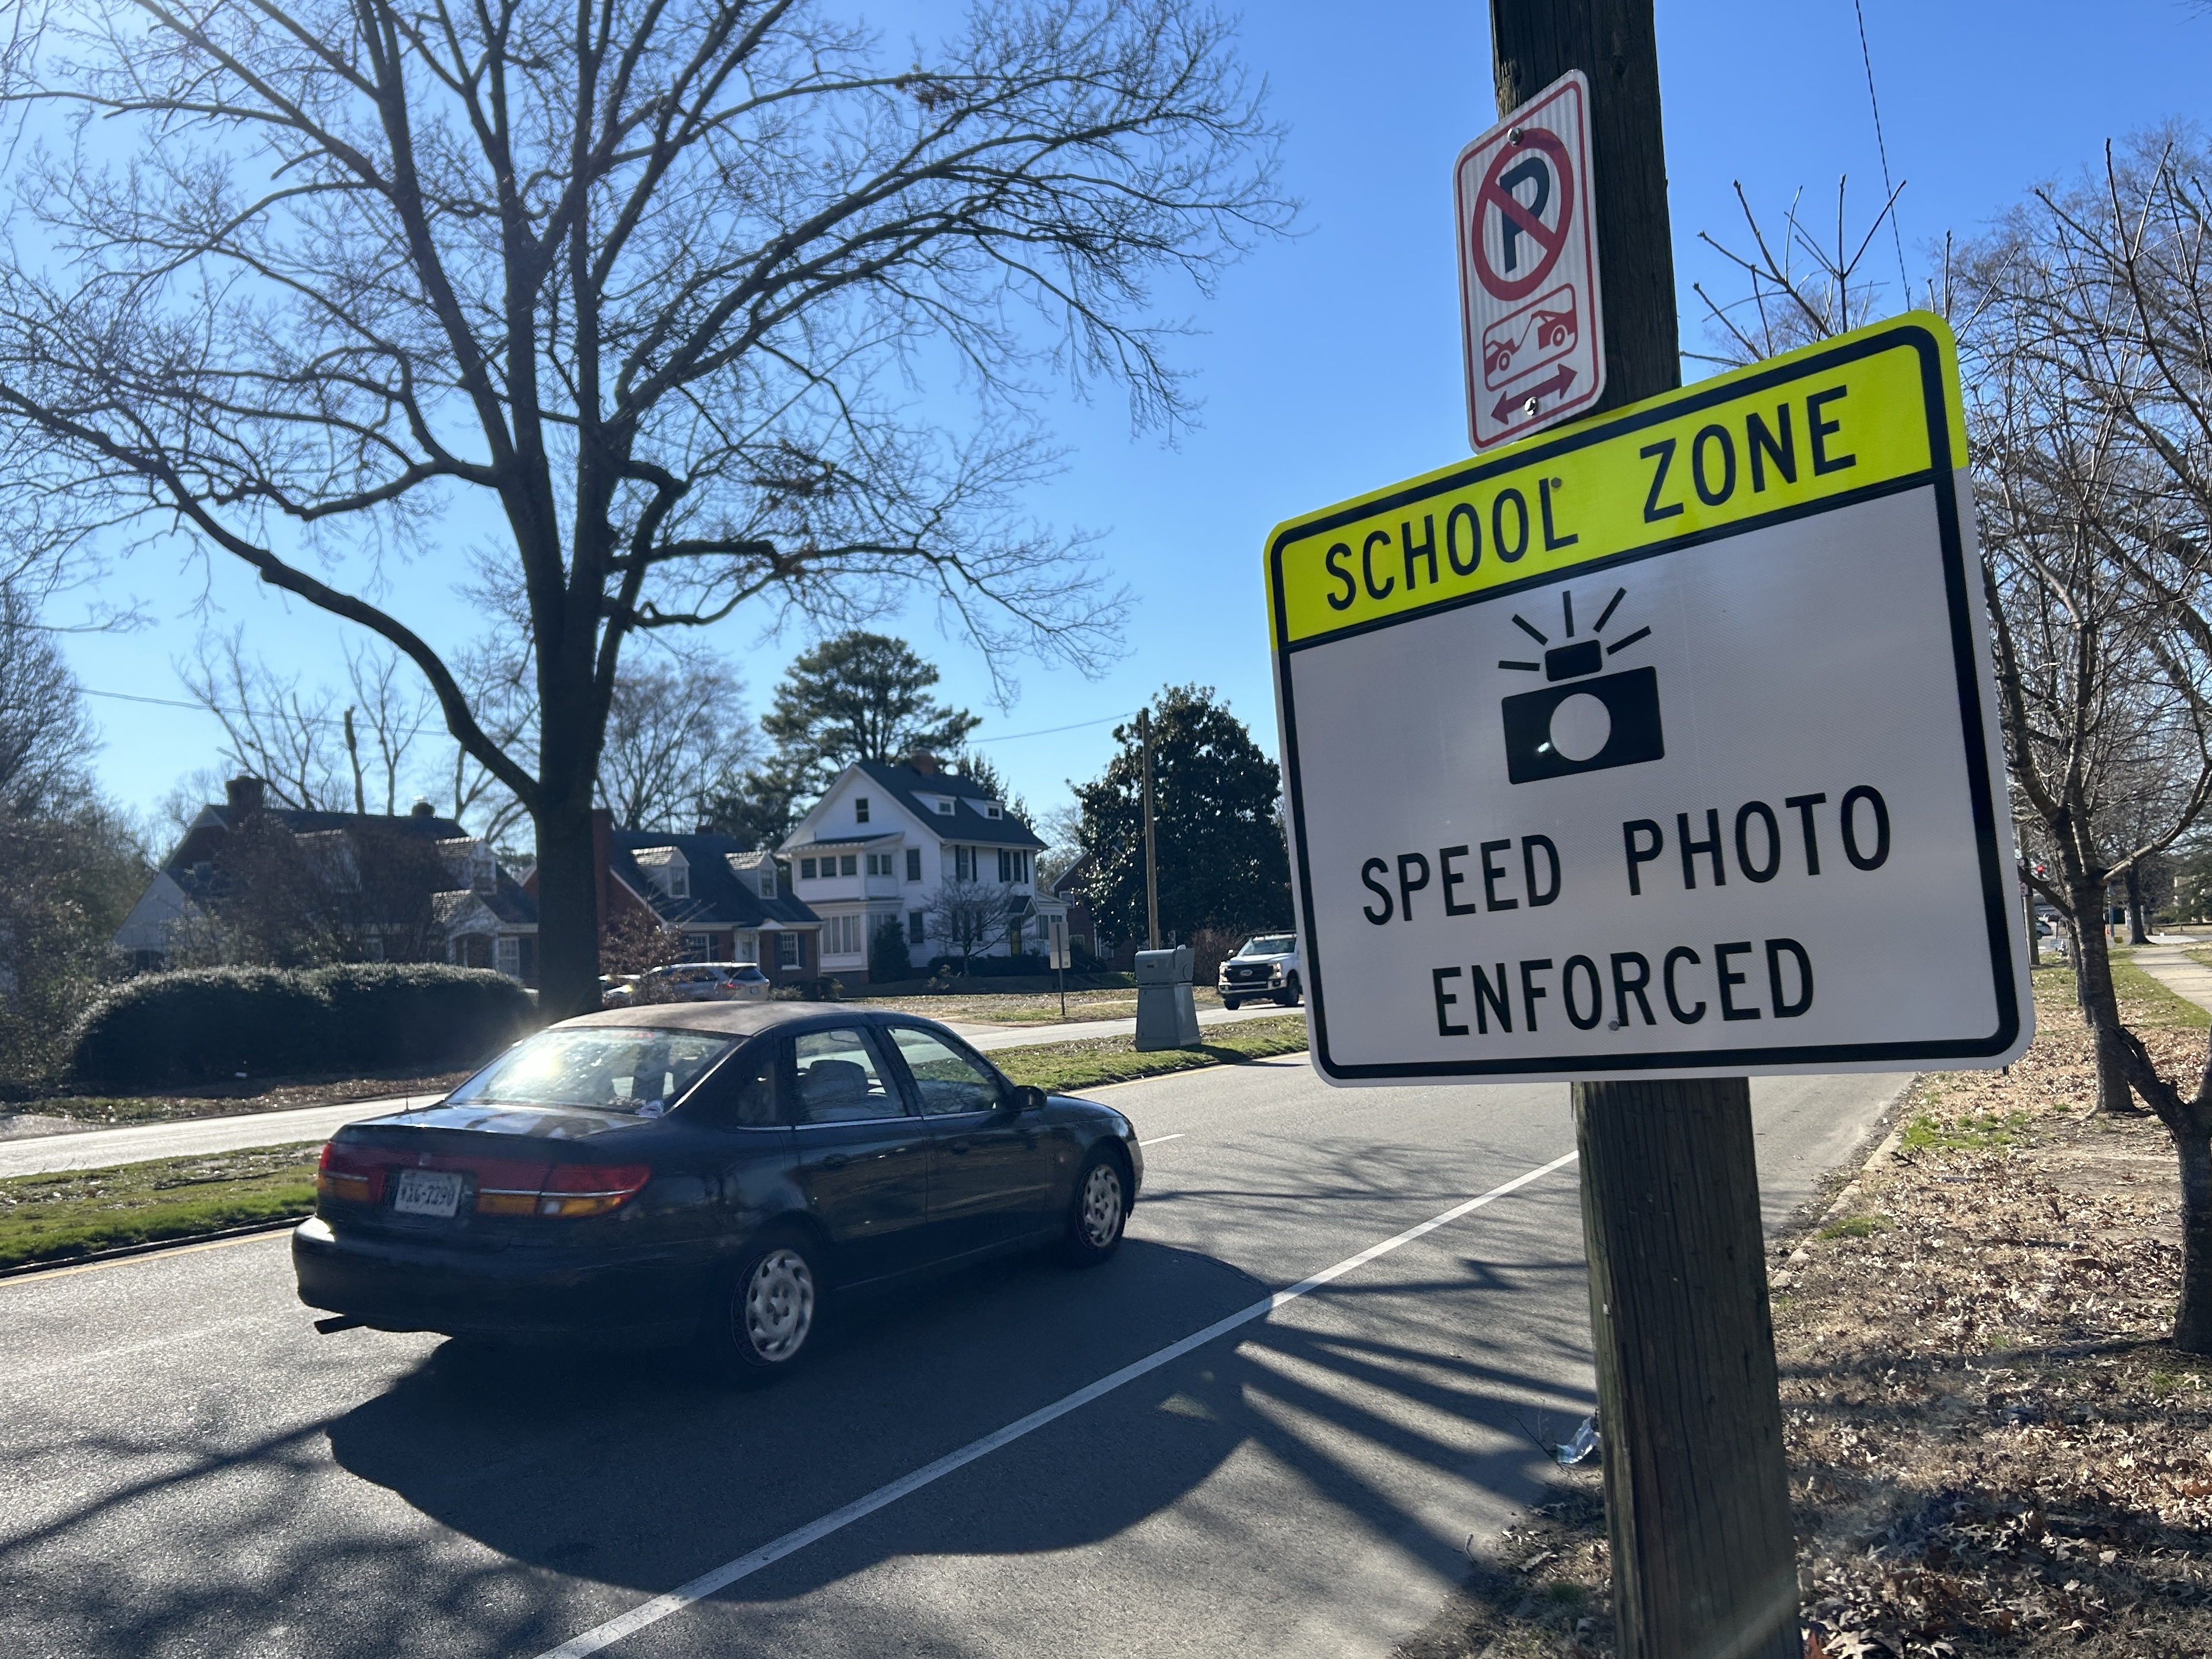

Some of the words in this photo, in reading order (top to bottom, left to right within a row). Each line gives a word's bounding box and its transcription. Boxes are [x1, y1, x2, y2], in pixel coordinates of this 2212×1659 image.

[1500, 157, 1550, 273] P
[1325, 477, 1579, 611] SCHOOL
[1639, 384, 1857, 524] ZONE
[1361, 834, 1562, 926] SPEED
[1622, 784, 1891, 896] PHOTO
[1432, 938, 1815, 1037] ENFORCED
